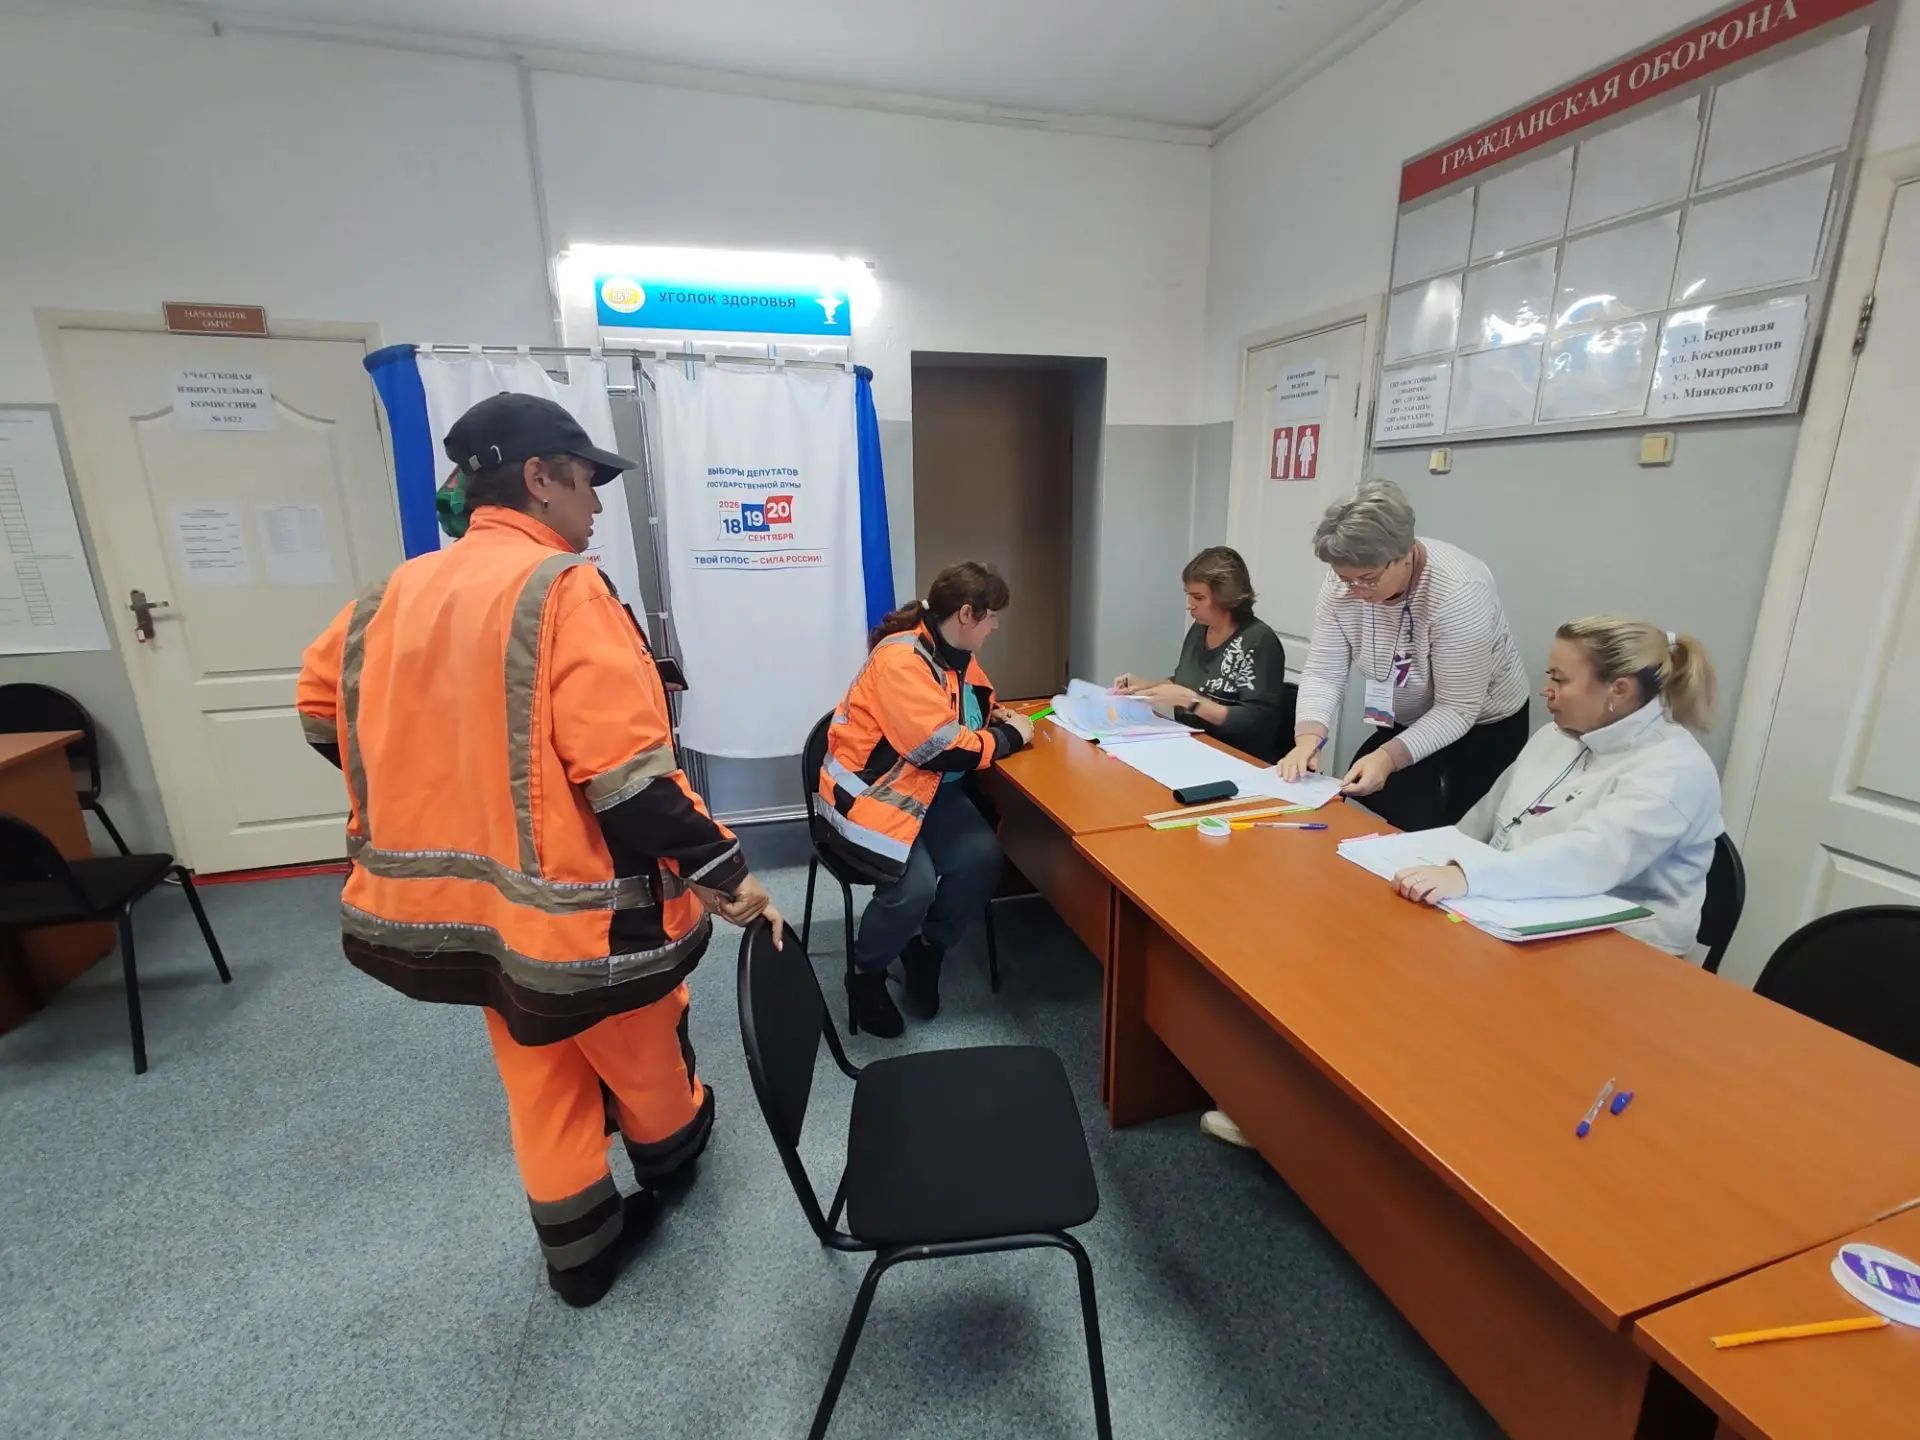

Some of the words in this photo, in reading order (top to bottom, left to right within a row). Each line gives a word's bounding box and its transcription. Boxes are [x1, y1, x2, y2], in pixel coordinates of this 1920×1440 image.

[1440, 74, 1621, 175] ГРАЖДАНСКАЯ
[1628, 0, 1798, 90] ОБОРОНА
[659, 291, 717, 304] УГОЛОК
[722, 295, 796, 309] ЗДОРОВЬЯ
[1704, 321, 1775, 342] Береговая
[1670, 355, 1687, 367] ул.
[1691, 340, 1782, 362] Космонавтов
[1694, 362, 1769, 380] Матросова
[1684, 380, 1774, 400] Маяковского
[708, 467, 745, 477] ВЫБОРЫ
[747, 468, 799, 478] ДЕПУТАТОВ
[707, 480, 779, 490] ГОСУДАРСТВЕННОЙ
[780, 481, 802, 489] ДУМЫ
[719, 501, 740, 509] 2026
[723, 518, 742, 534] 18
[744, 510, 764, 527] 19
[767, 501, 789, 519] 20
[748, 533, 794, 542] СЕНТЯБРЯ
[695, 555, 718, 564] ТВОЙ
[720, 556, 750, 565] ГОЛОС
[760, 556, 784, 565] СИЛА
[787, 555, 822, 564] РОССИИ!
